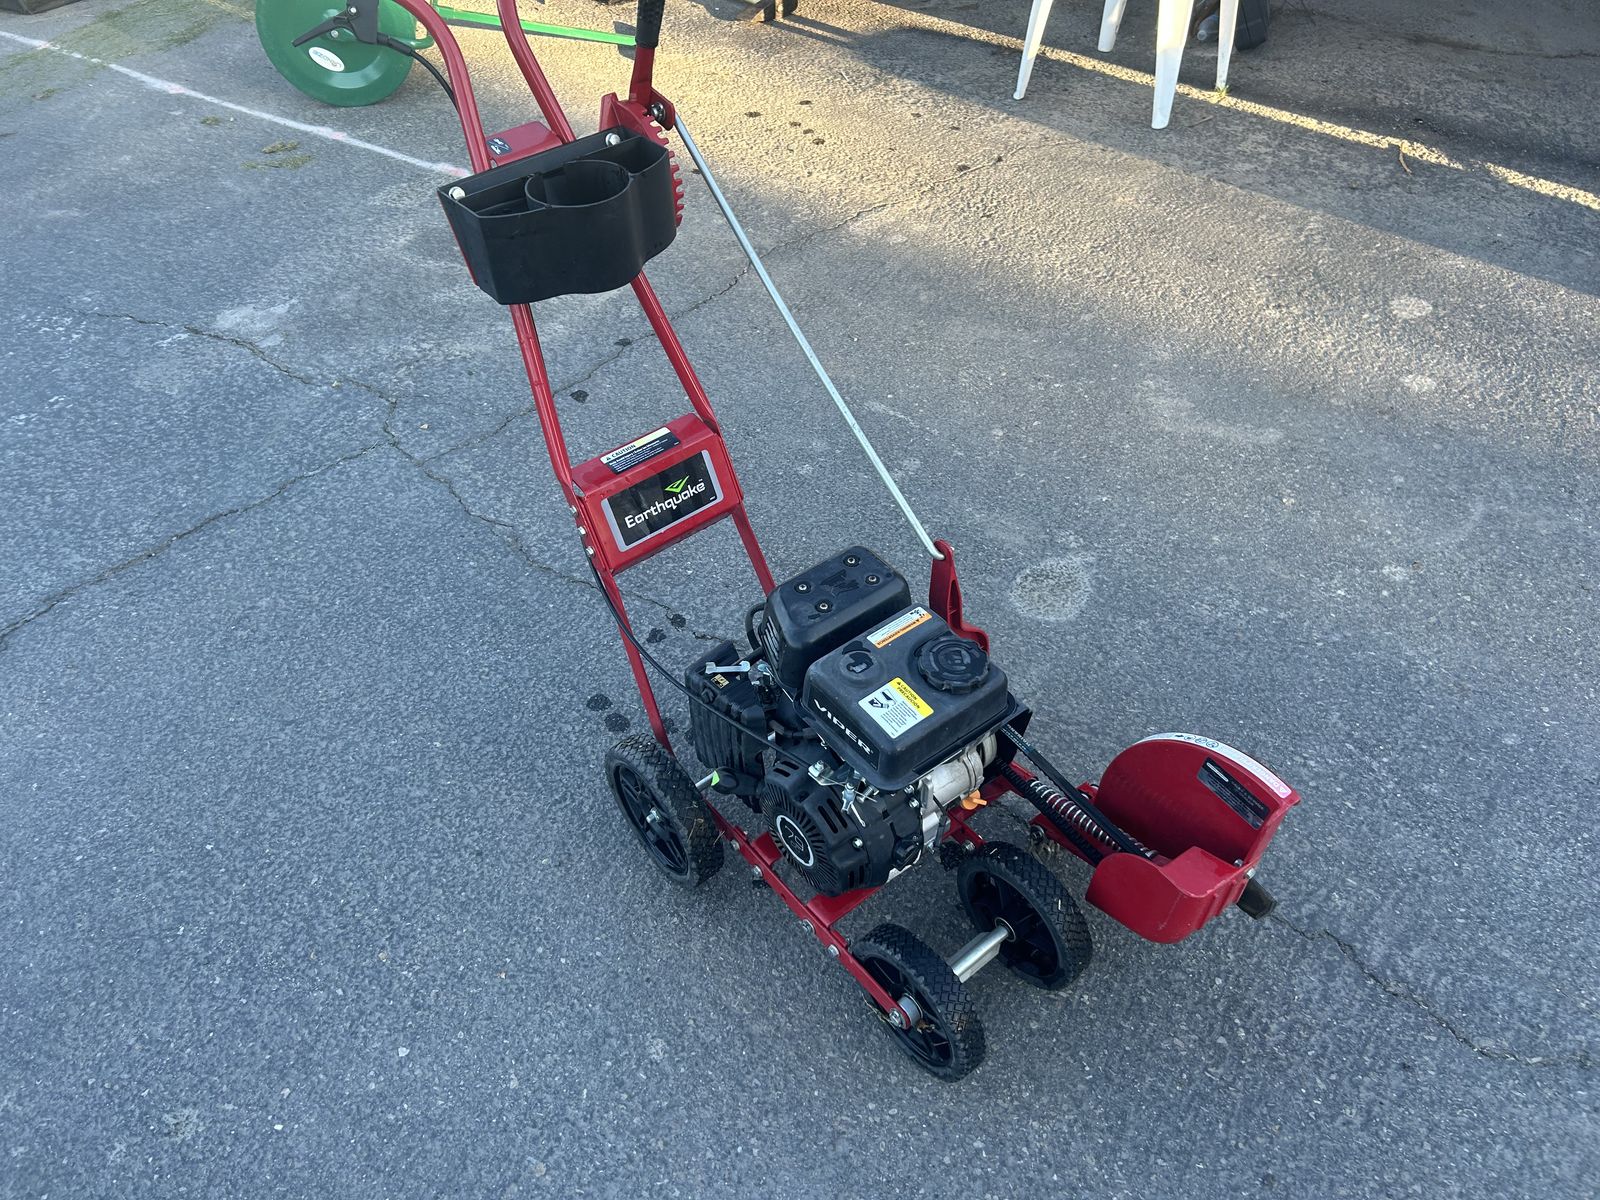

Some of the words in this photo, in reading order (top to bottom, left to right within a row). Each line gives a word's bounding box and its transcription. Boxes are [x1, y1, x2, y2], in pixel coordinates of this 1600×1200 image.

[611, 444, 636, 458] CAUTION
[624, 482, 706, 528] Earthquake
[900, 684, 918, 700] CAUTION
[814, 699, 871, 755] VIPER
